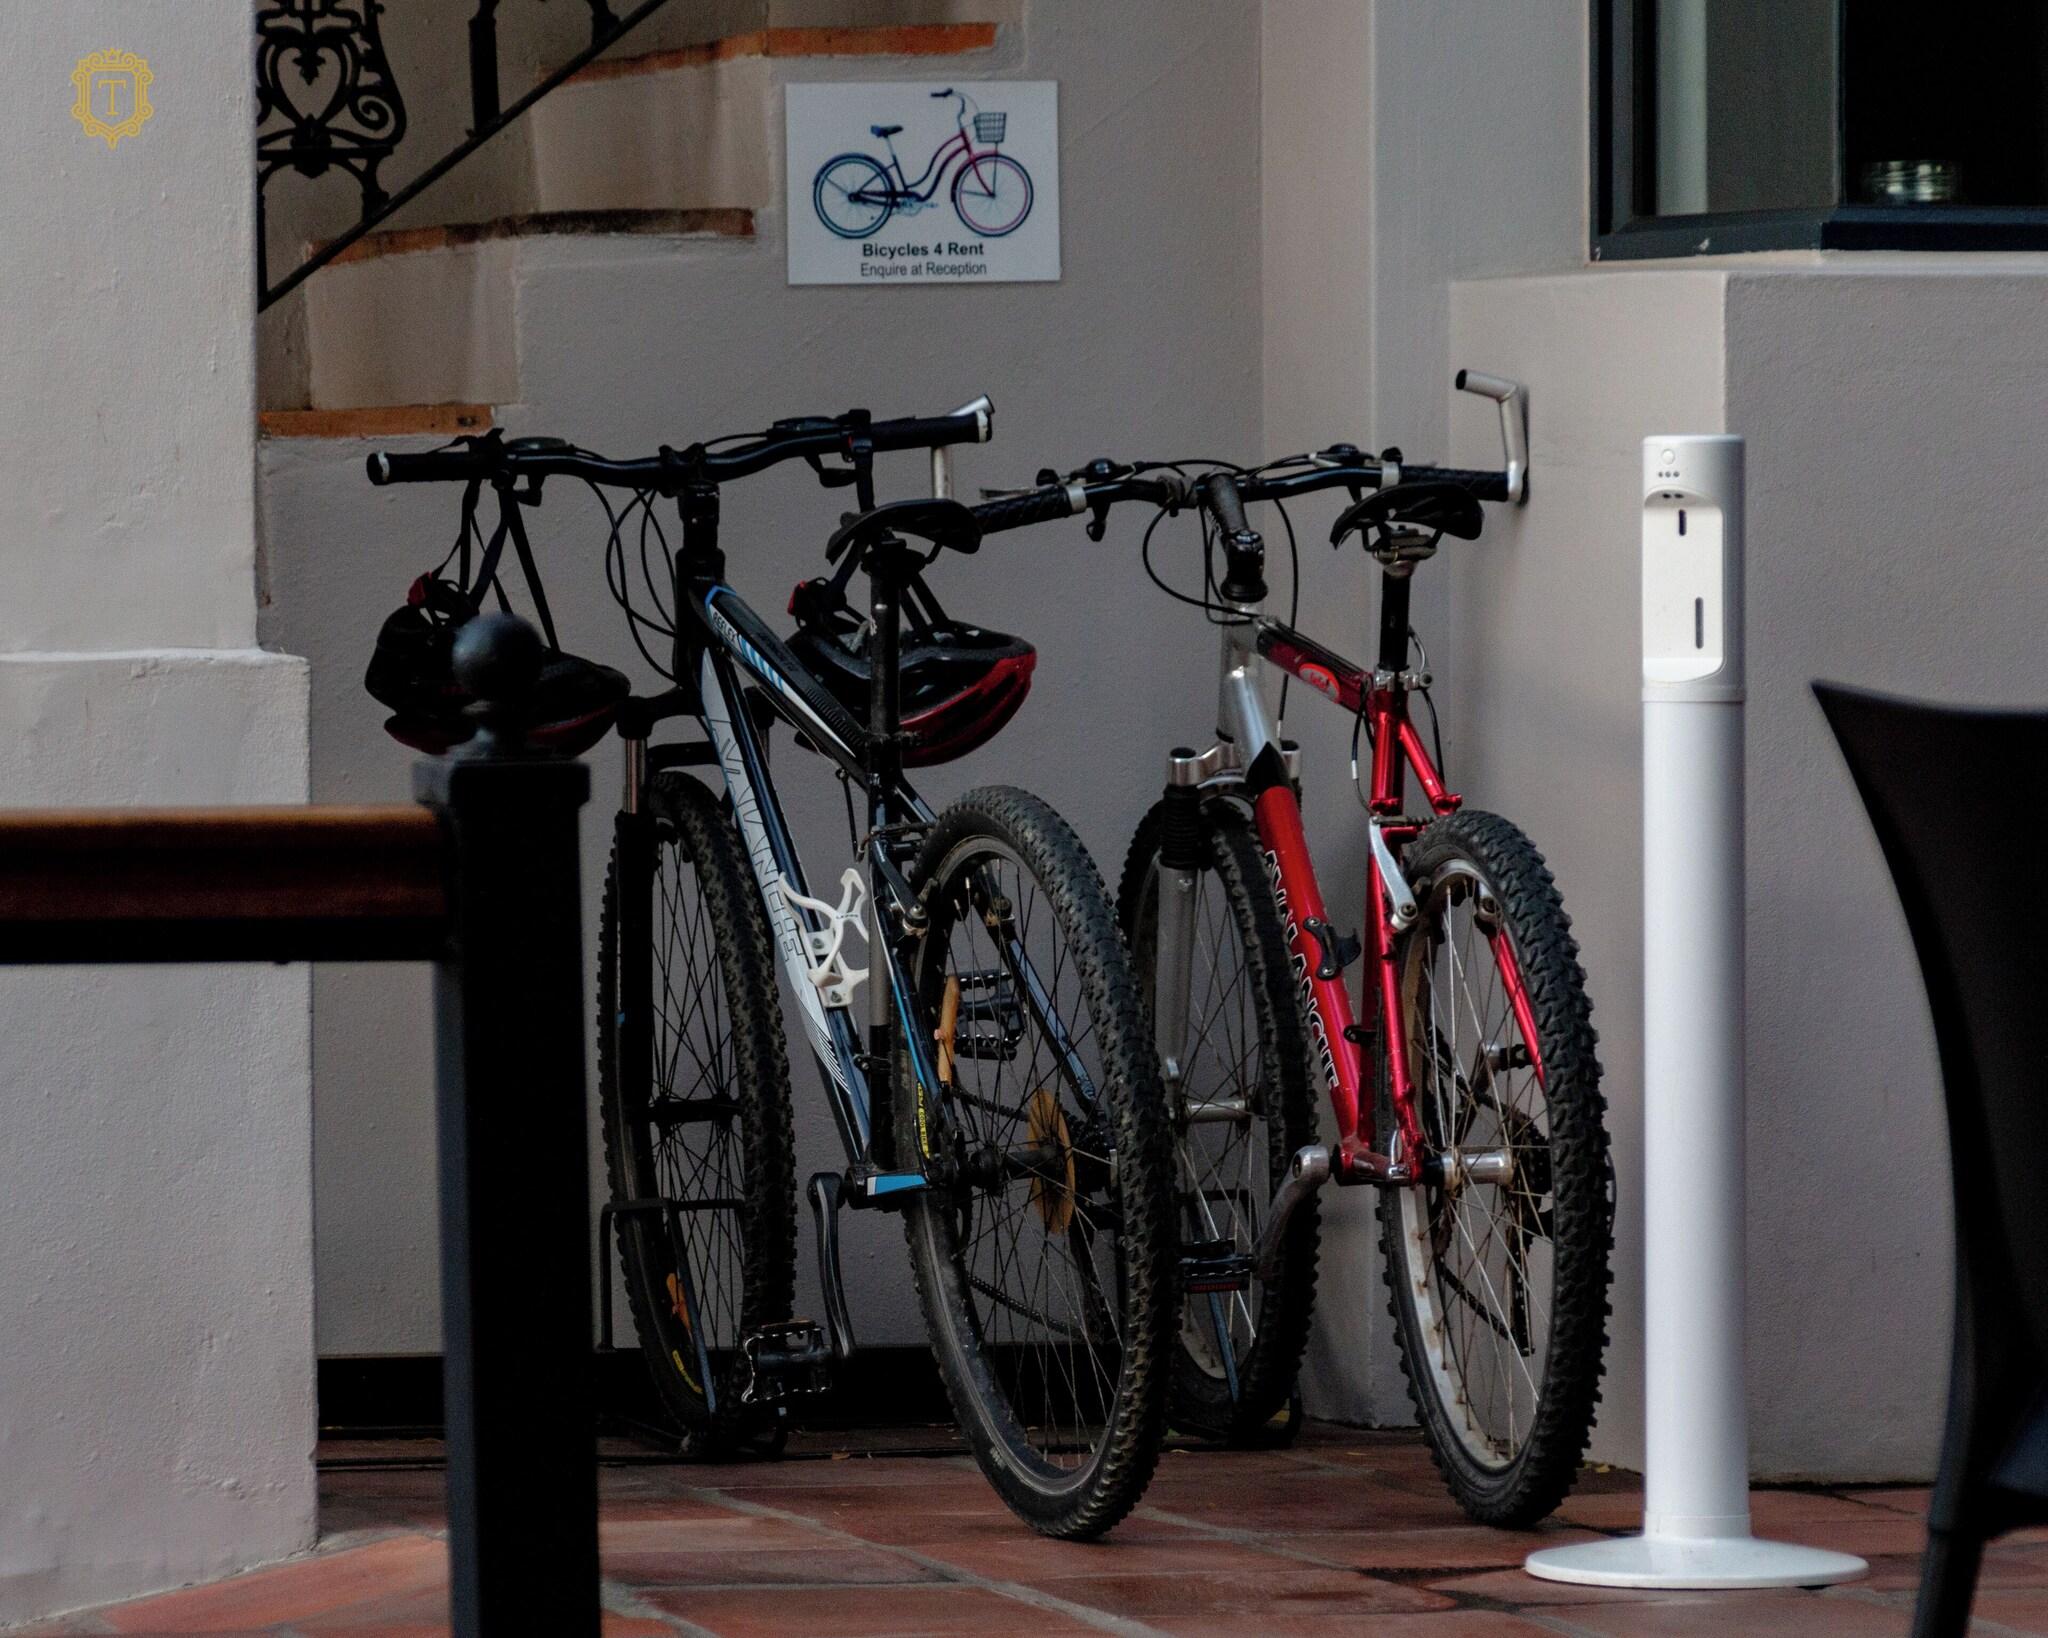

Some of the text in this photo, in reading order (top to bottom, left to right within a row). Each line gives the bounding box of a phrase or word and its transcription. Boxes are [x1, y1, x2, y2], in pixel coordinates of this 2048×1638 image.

[862, 241, 984, 260] Bicycles 4 Rent
[860, 261, 987, 278] Enquire at Reception
